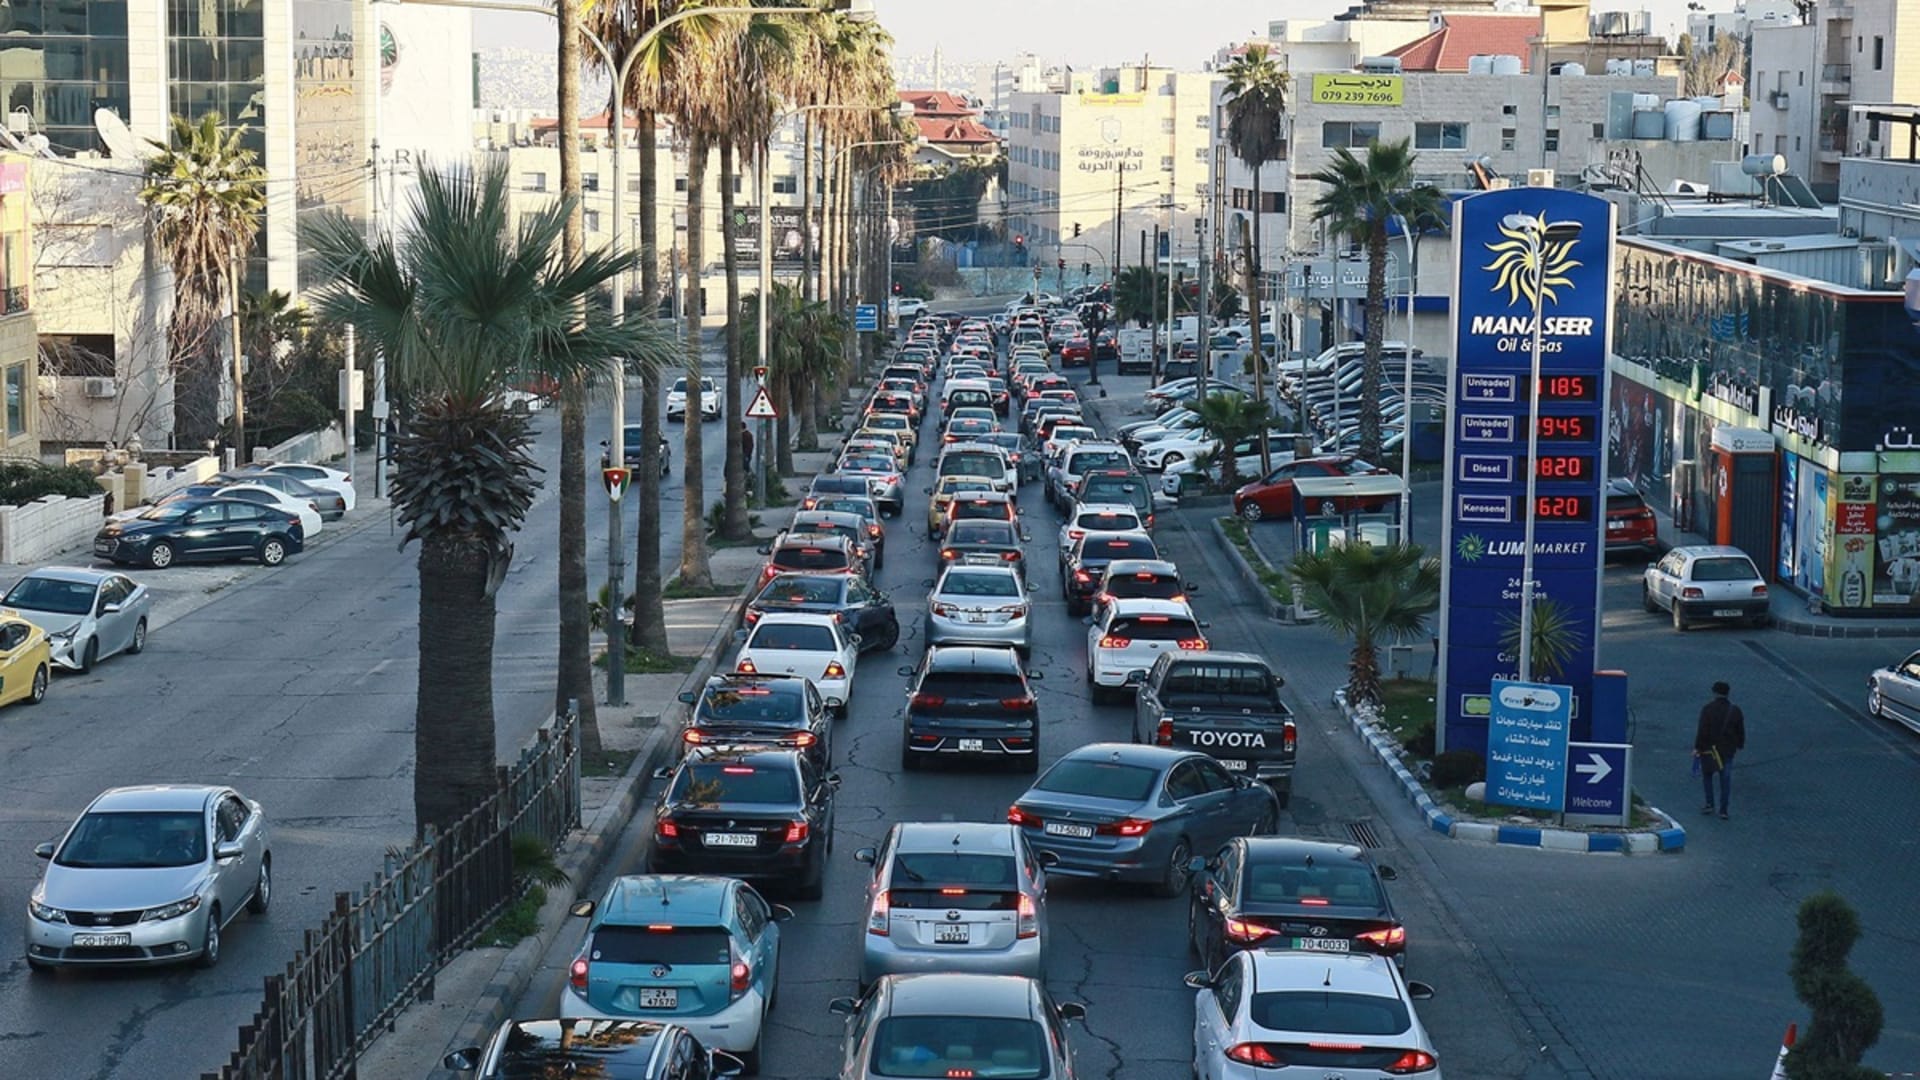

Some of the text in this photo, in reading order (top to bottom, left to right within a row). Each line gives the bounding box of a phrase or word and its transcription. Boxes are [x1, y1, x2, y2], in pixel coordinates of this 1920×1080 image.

[1321, 91, 1393, 102] 079 239 7696
[1471, 316, 1593, 336] MANASEER
[1497, 338, 1516, 352] Oil
[1520, 338, 1531, 352] &
[1467, 379, 1510, 387] Unleaded
[1483, 389, 1494, 397] 95
[1466, 419, 1508, 428] Unleaded
[1472, 464, 1500, 473] Diesel
[1463, 503, 1505, 513] Kerosene
[1487, 541, 1587, 556] LUM MARKET
[1508, 578, 1521, 588] 24
[1189, 731, 1266, 748] TOYOTA
[1572, 796, 1613, 808] Welcome
